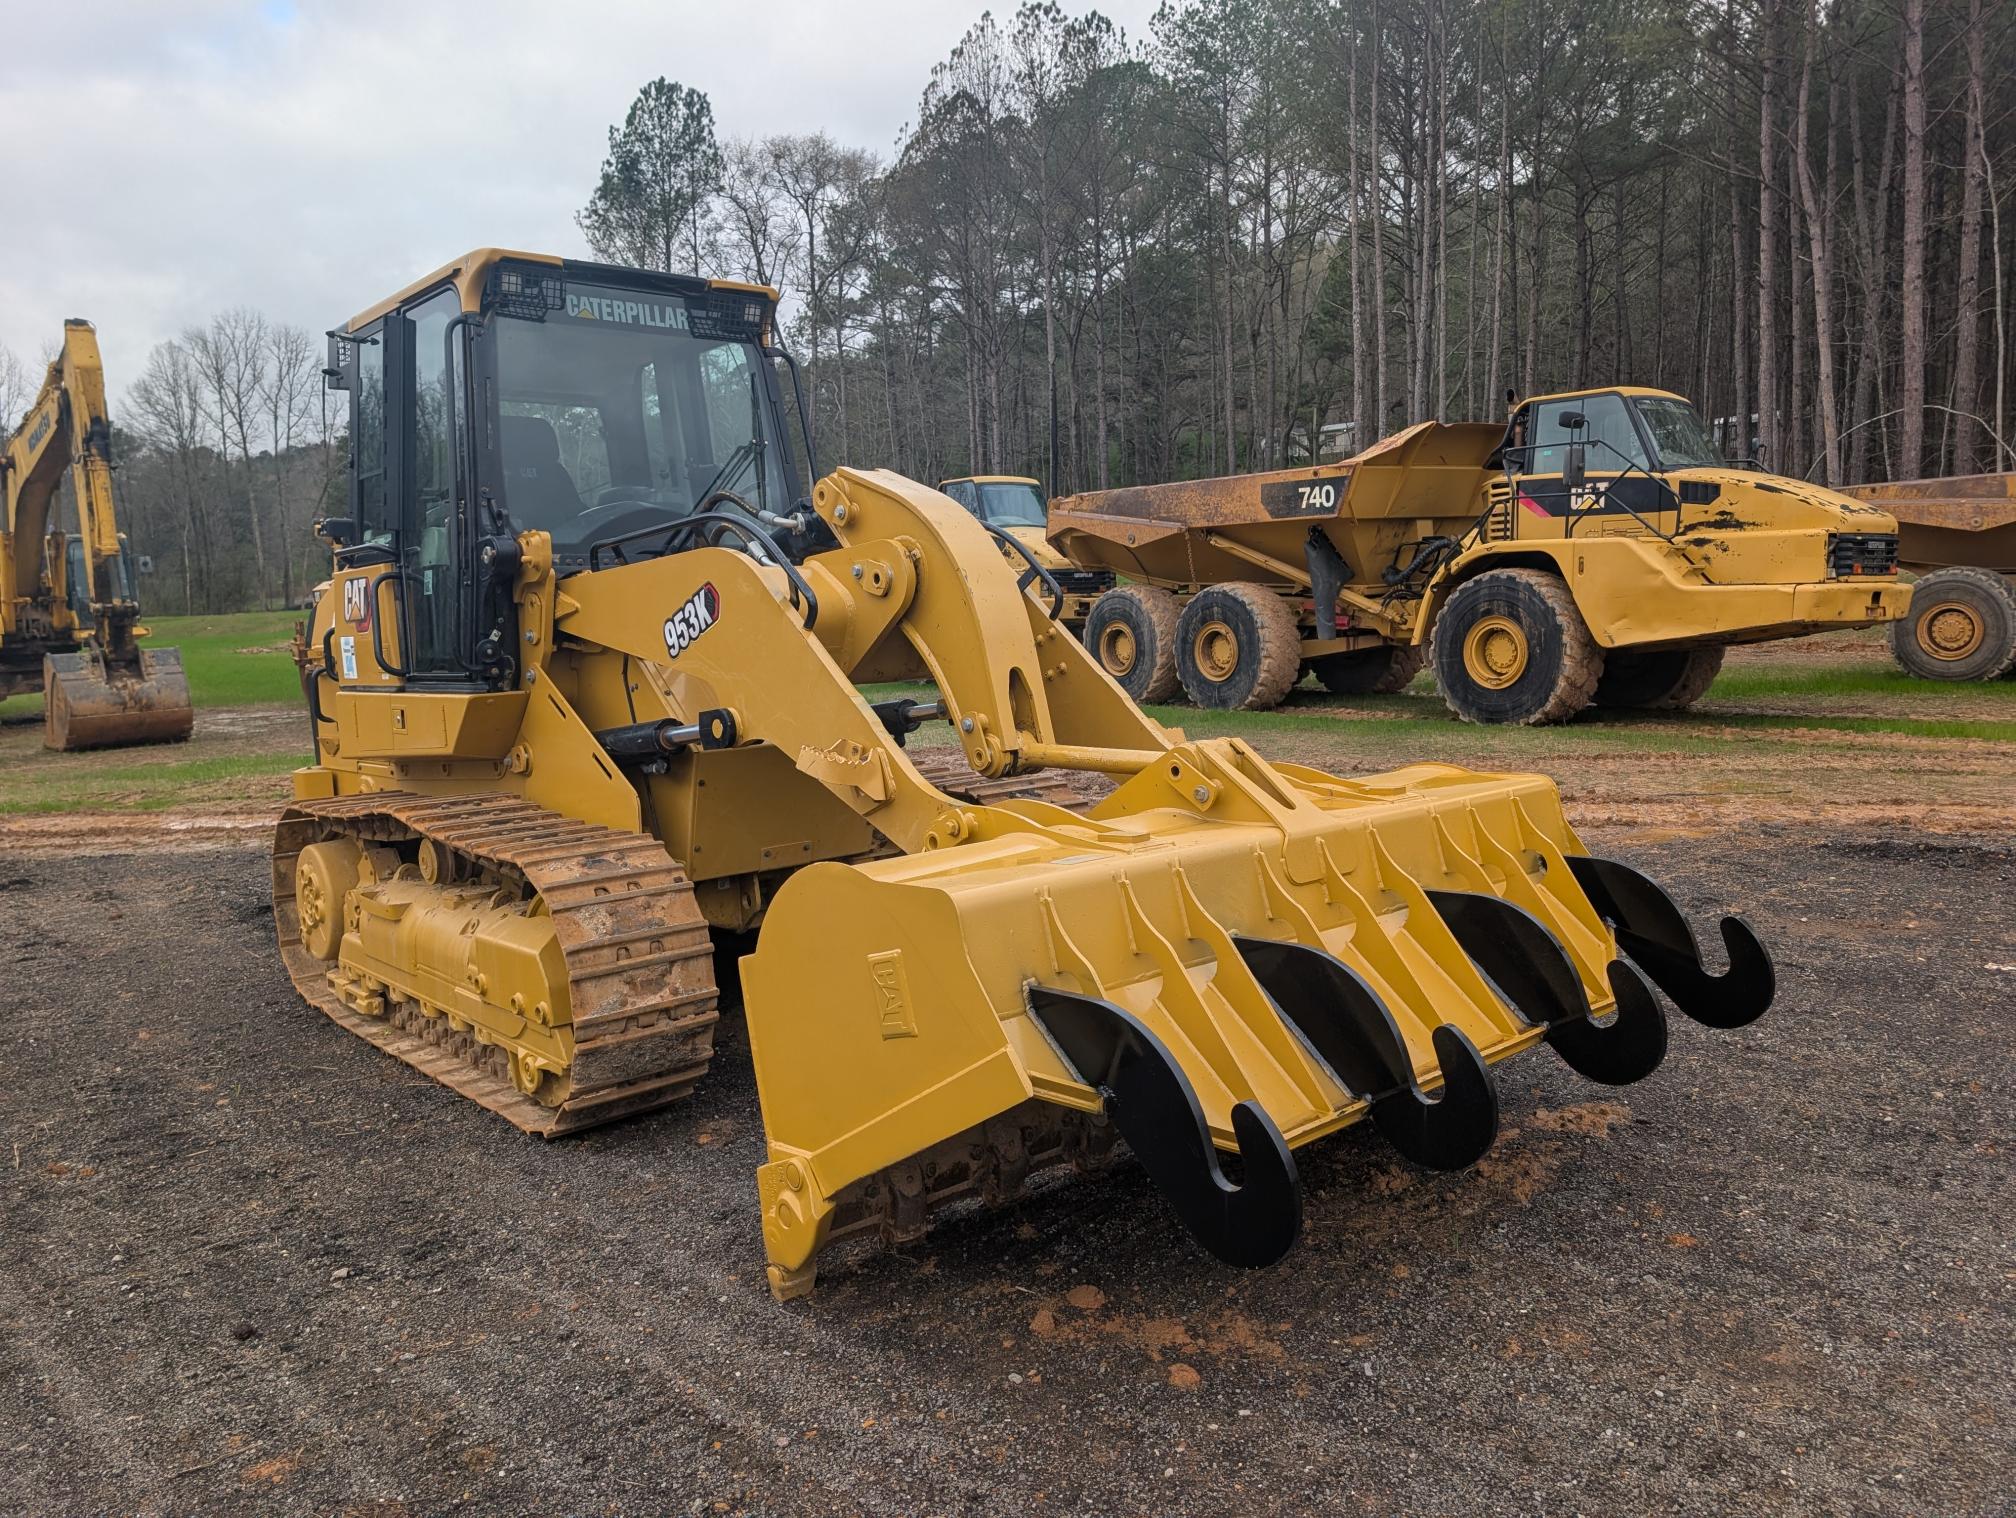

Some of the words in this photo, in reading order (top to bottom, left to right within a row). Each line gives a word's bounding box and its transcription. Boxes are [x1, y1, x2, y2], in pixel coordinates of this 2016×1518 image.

[566, 294, 689, 330] CATERPILLAR
[1298, 484, 1335, 509] 740
[1570, 481, 1609, 511] CAT
[344, 578, 367, 621] CAT
[664, 588, 713, 657] 953K
[872, 959, 911, 1031] CAT
